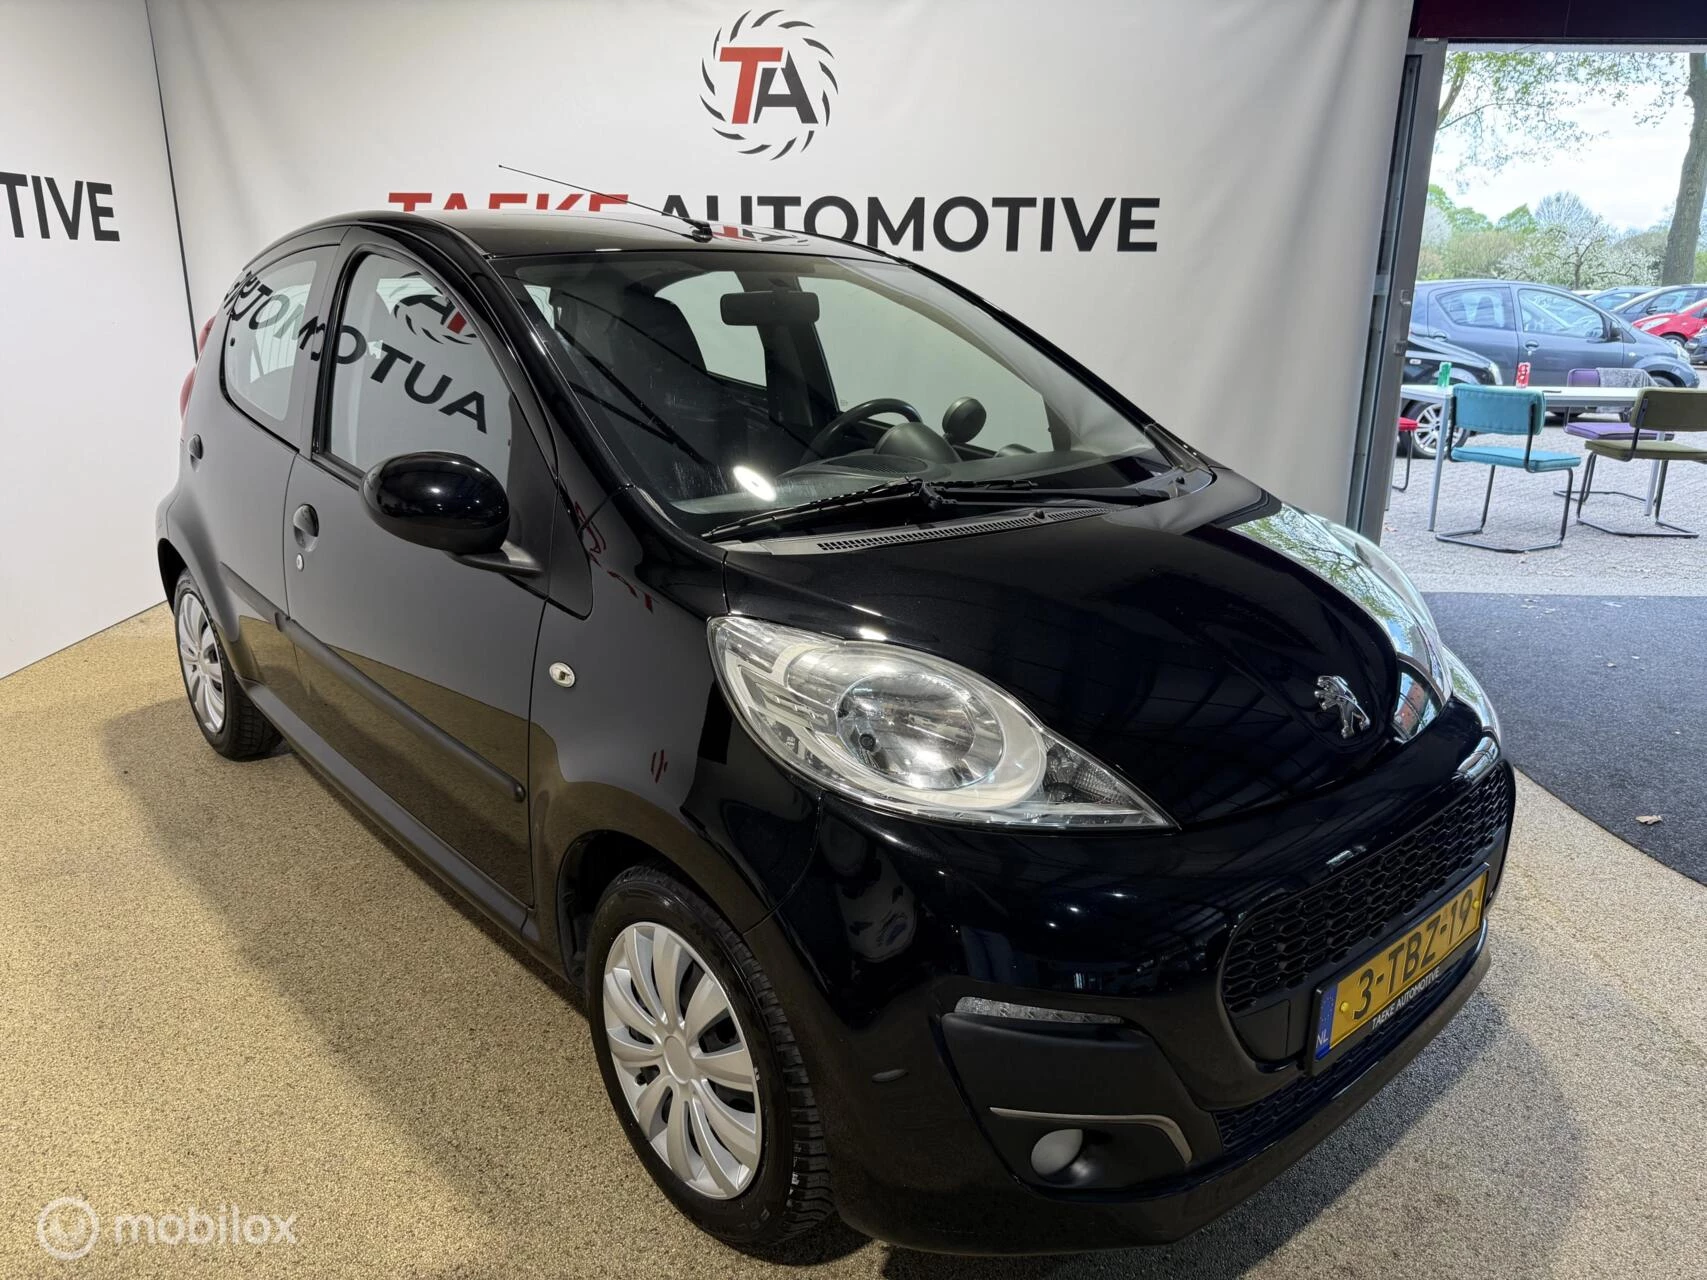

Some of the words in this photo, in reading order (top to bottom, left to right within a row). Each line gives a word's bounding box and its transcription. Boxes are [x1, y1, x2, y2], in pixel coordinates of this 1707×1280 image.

[719, 46, 819, 125] TA
[0, 171, 120, 242] TIVE
[1353, 888, 1474, 1021] 3-TBZ-19
[1371, 998, 1396, 1030] TAEKE
[1395, 965, 1441, 1008] AUTOMOTIVE
[1316, 1028, 1329, 1049] NL
